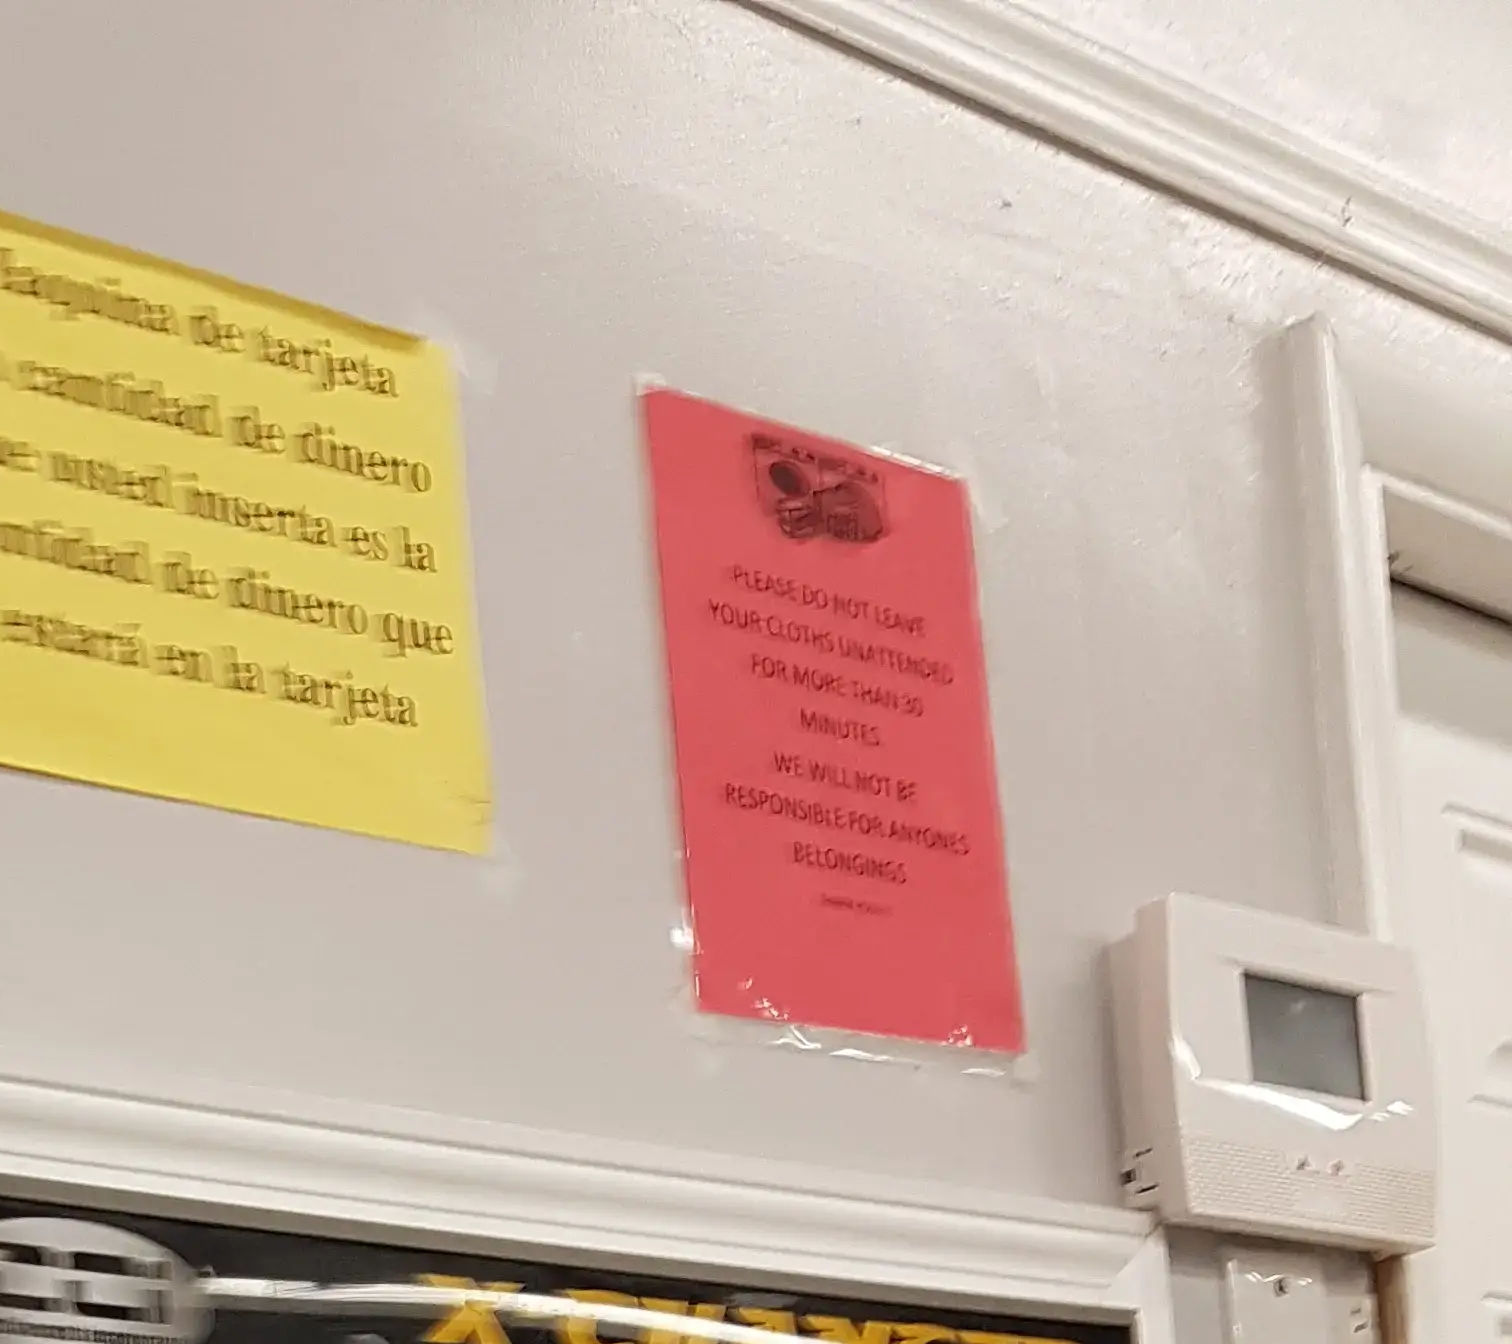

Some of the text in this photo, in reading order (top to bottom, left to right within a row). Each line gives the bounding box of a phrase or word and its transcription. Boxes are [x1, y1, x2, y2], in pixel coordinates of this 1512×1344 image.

[186, 305, 245, 353] de
[252, 324, 399, 398] tarjeta
[14, 360, 222, 438] cantidad
[230, 406, 287, 454] de
[292, 421, 432, 493] dinero
[42, 449, 175, 508] usted
[174, 473, 338, 548] inserta
[341, 526, 389, 561] es
[391, 526, 438, 573] la
[159, 550, 219, 599] de
[225, 566, 368, 635] dinero
[373, 611, 455, 658] que
[731, 565, 927, 637] PLEASE DO NOT LEAVE
[708, 599, 953, 684] YOUR CLOTHS UNATTENDED
[153, 644, 214, 683] en
[216, 644, 267, 694] la
[272, 661, 419, 728] tarjeta
[751, 653, 787, 681] FOR
[793, 664, 846, 697] MORE
[851, 681, 896, 710] THAN
[800, 707, 880, 747] MINUTES
[725, 782, 847, 830] RESPONSIBLE
[849, 810, 884, 838] FOR
[774, 751, 917, 802] WE WILL NOT BE
[793, 840, 907, 885] BELONGINGS
